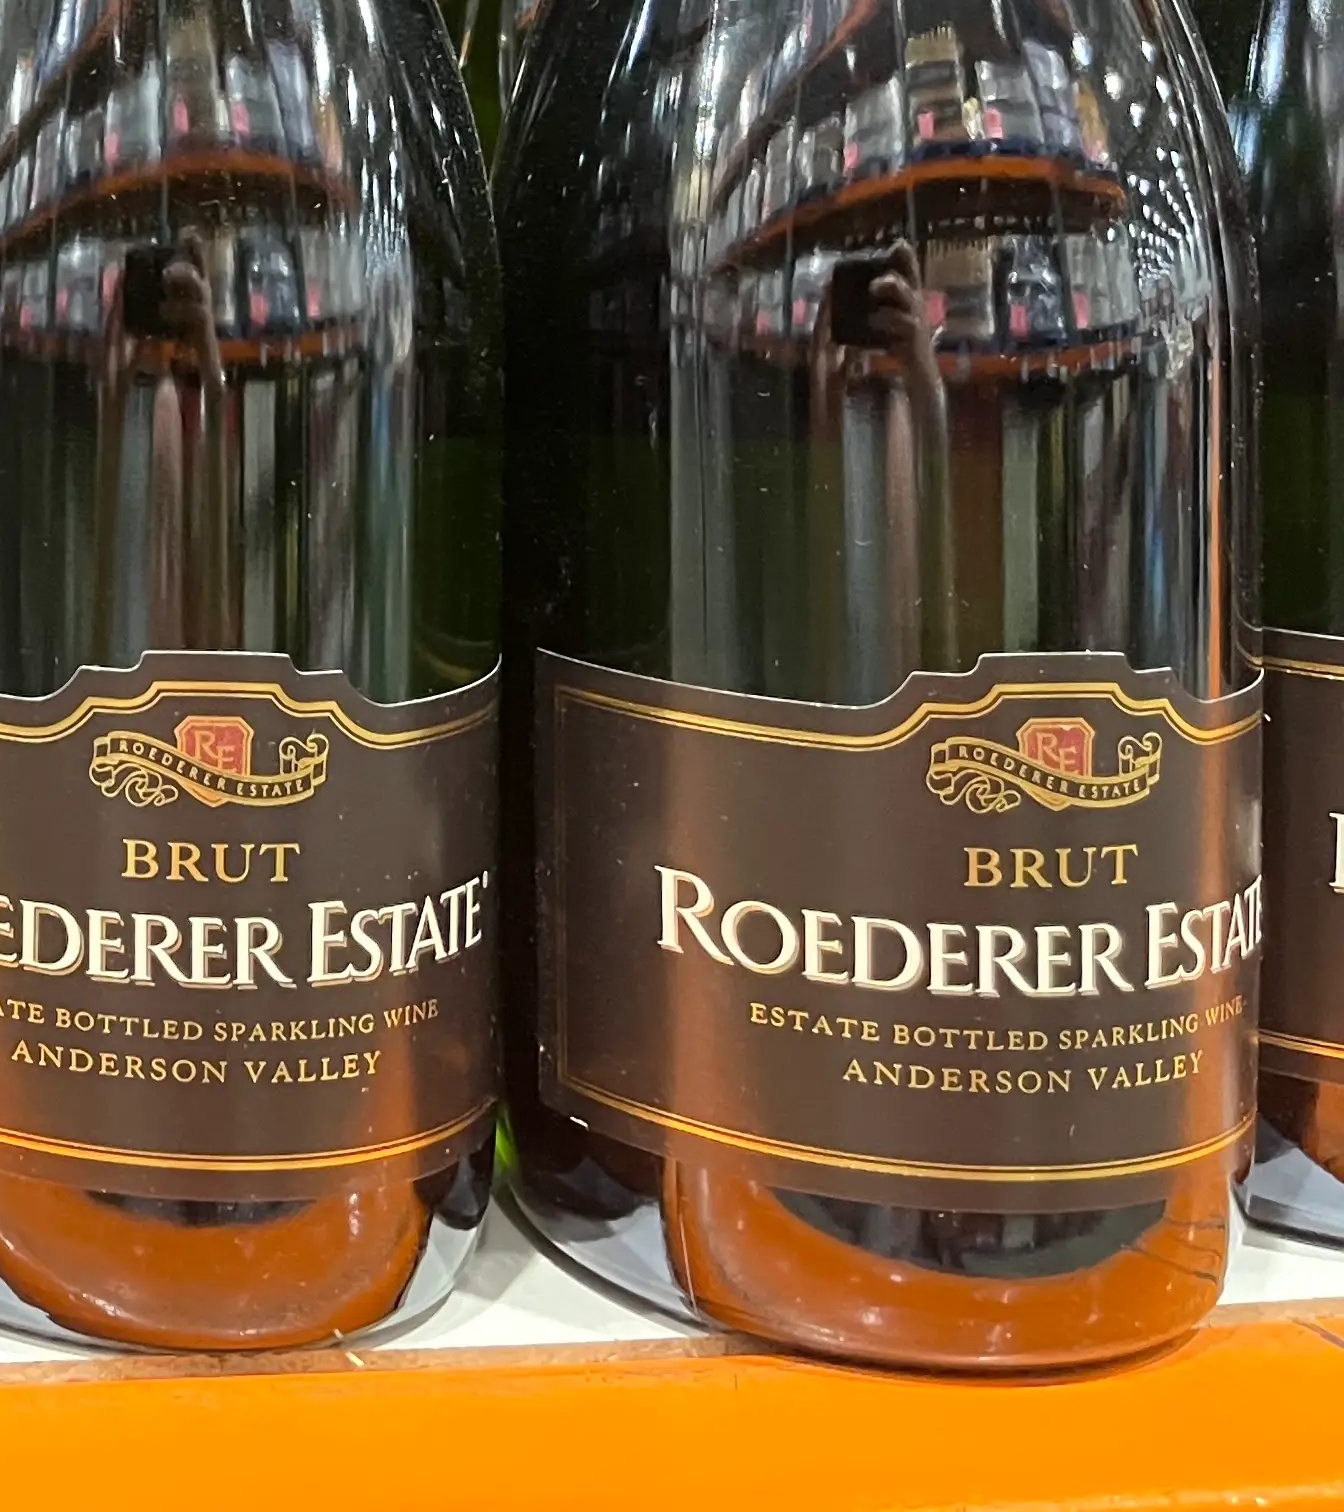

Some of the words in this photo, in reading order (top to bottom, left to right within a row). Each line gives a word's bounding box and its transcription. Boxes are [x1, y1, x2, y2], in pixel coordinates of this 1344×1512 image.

[119, 740, 225, 792] ROEDERER
[236, 779, 304, 797] ESTATE
[959, 745, 1069, 794] ROEDERER
[1079, 778, 1141, 798] ESTATE
[120, 838, 301, 884] BRUT
[963, 843, 1139, 888] BRUT
[654, 864, 1136, 998] ROEDERER
[55, 1007, 204, 1042] BOTTLED
[213, 1013, 375, 1042] SPARKLING
[383, 998, 439, 1029] WINE
[750, 1002, 881, 1042] ESTATE
[893, 1023, 1049, 1051] BOTTLED
[1059, 1012, 1199, 1050] SPARKLING
[1204, 995, 1244, 1026] WINE
[10, 1039, 228, 1084] ANDERSON
[243, 1050, 382, 1084] VALLEY
[842, 1058, 1072, 1094] ANDERSON
[1087, 1050, 1204, 1092] VALLEY
